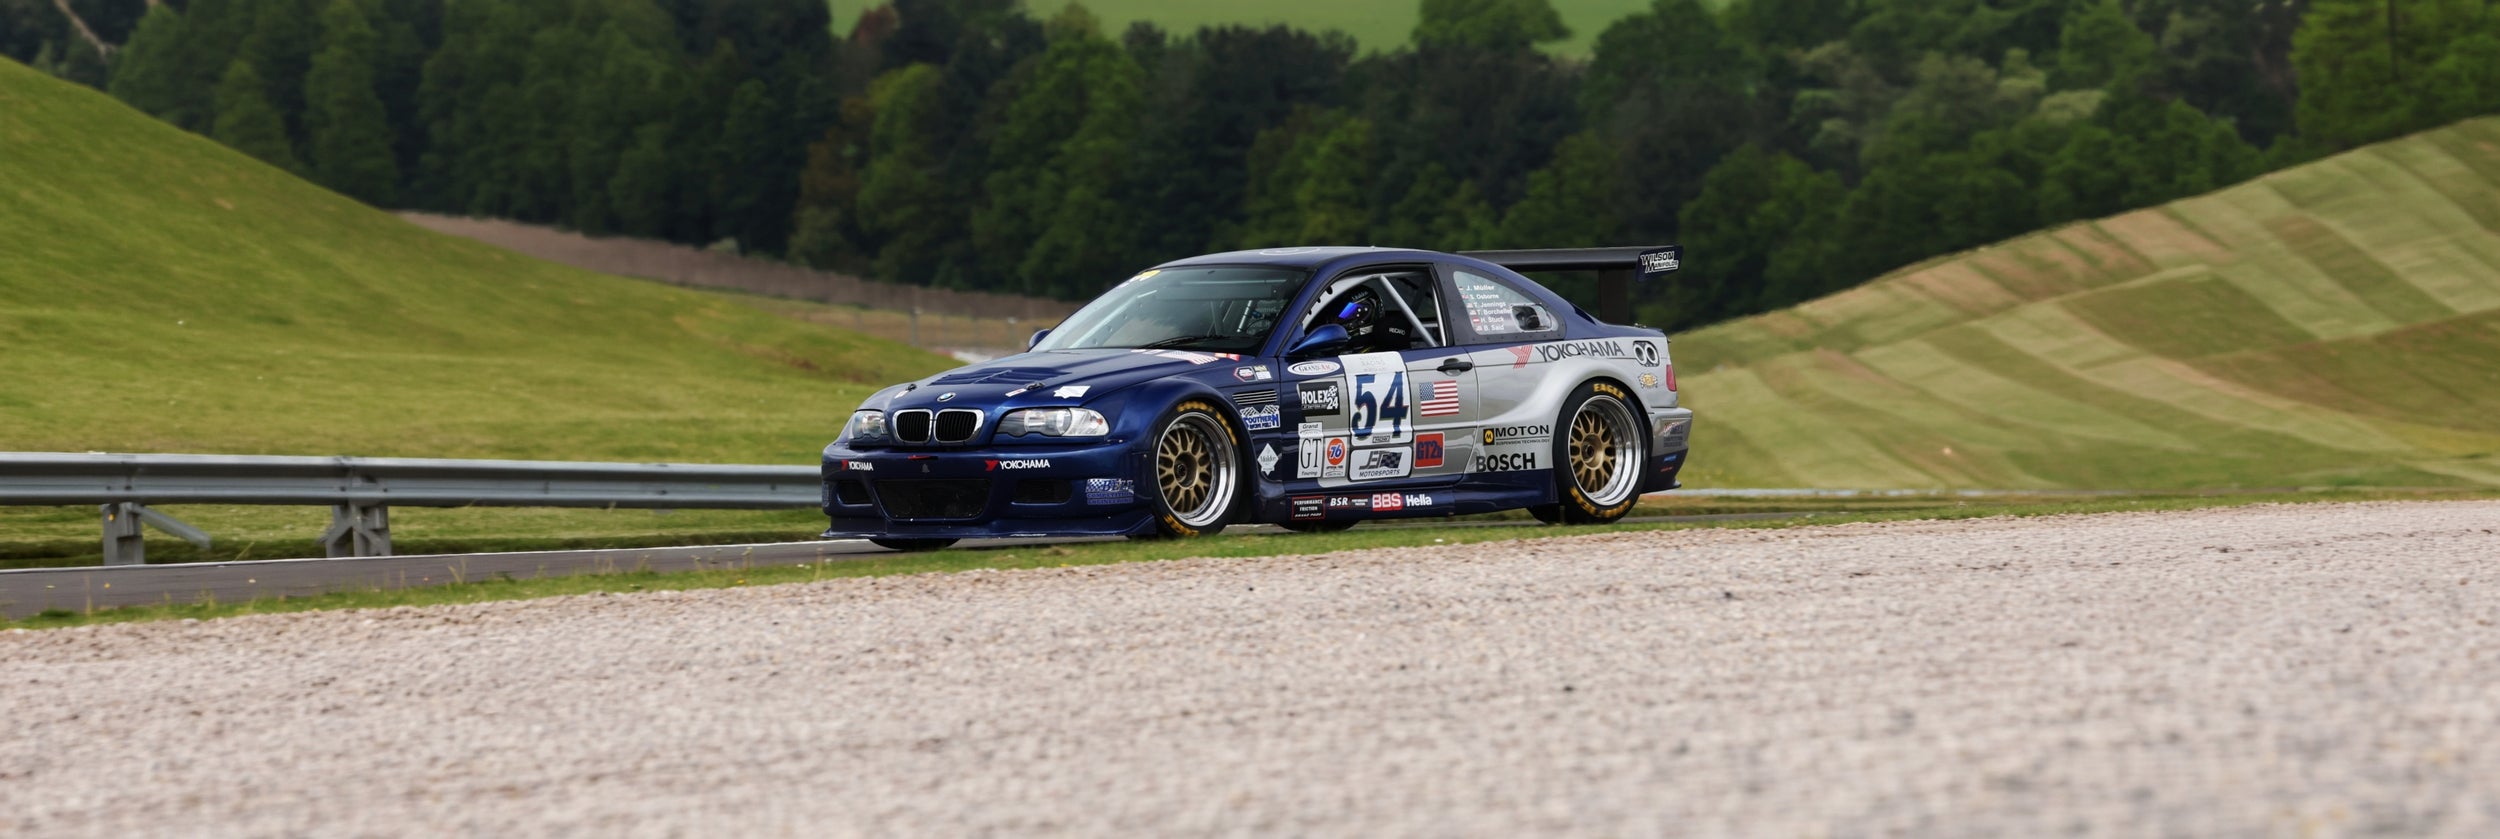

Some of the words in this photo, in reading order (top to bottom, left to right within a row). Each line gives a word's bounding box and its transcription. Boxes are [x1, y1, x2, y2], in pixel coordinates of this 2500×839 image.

[1640, 251, 1675, 266] WILSON
[1535, 340, 1625, 362] YOKOHAMA
[1301, 389, 1329, 405] ROLEX
[1593, 383, 1625, 400] EAGLE
[1326, 396, 1339, 410] 24
[1351, 371, 1409, 439] 54
[1495, 425, 1550, 438] MOTON
[1300, 438, 1321, 469] GT
[1330, 444, 1342, 458] 76
[848, 461, 874, 471] YOKOHAMA
[999, 459, 1051, 470] YOKOHAMA
[1475, 452, 1536, 472] BOSCH
[1359, 469, 1400, 478] MOTORSPORTS
[1330, 497, 1348, 507] BSR
[1371, 493, 1401, 508] BBS
[1405, 493, 1433, 507] Hella
